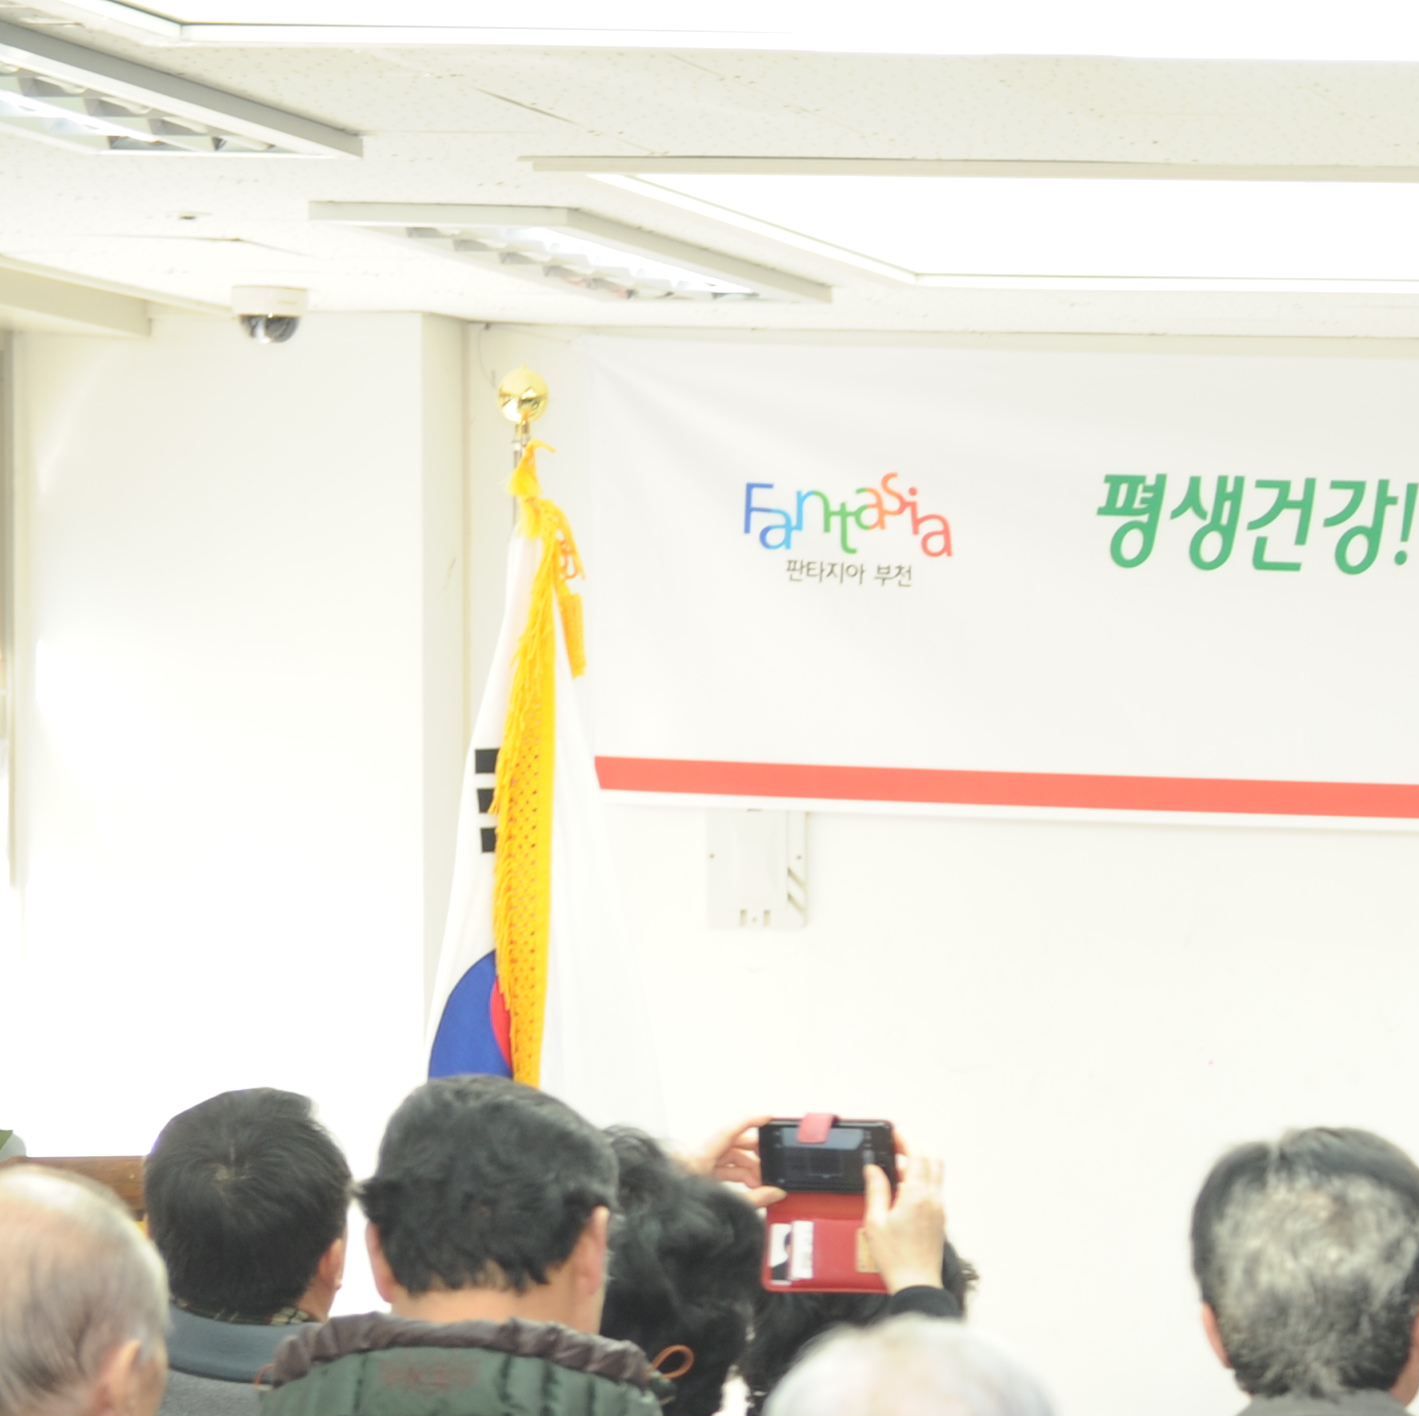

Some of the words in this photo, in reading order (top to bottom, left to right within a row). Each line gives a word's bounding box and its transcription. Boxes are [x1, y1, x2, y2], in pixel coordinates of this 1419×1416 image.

[1097, 473, 1419, 577] 평생건강!
[786, 560, 866, 586] 판타지아
[873, 564, 912, 588] 부천
